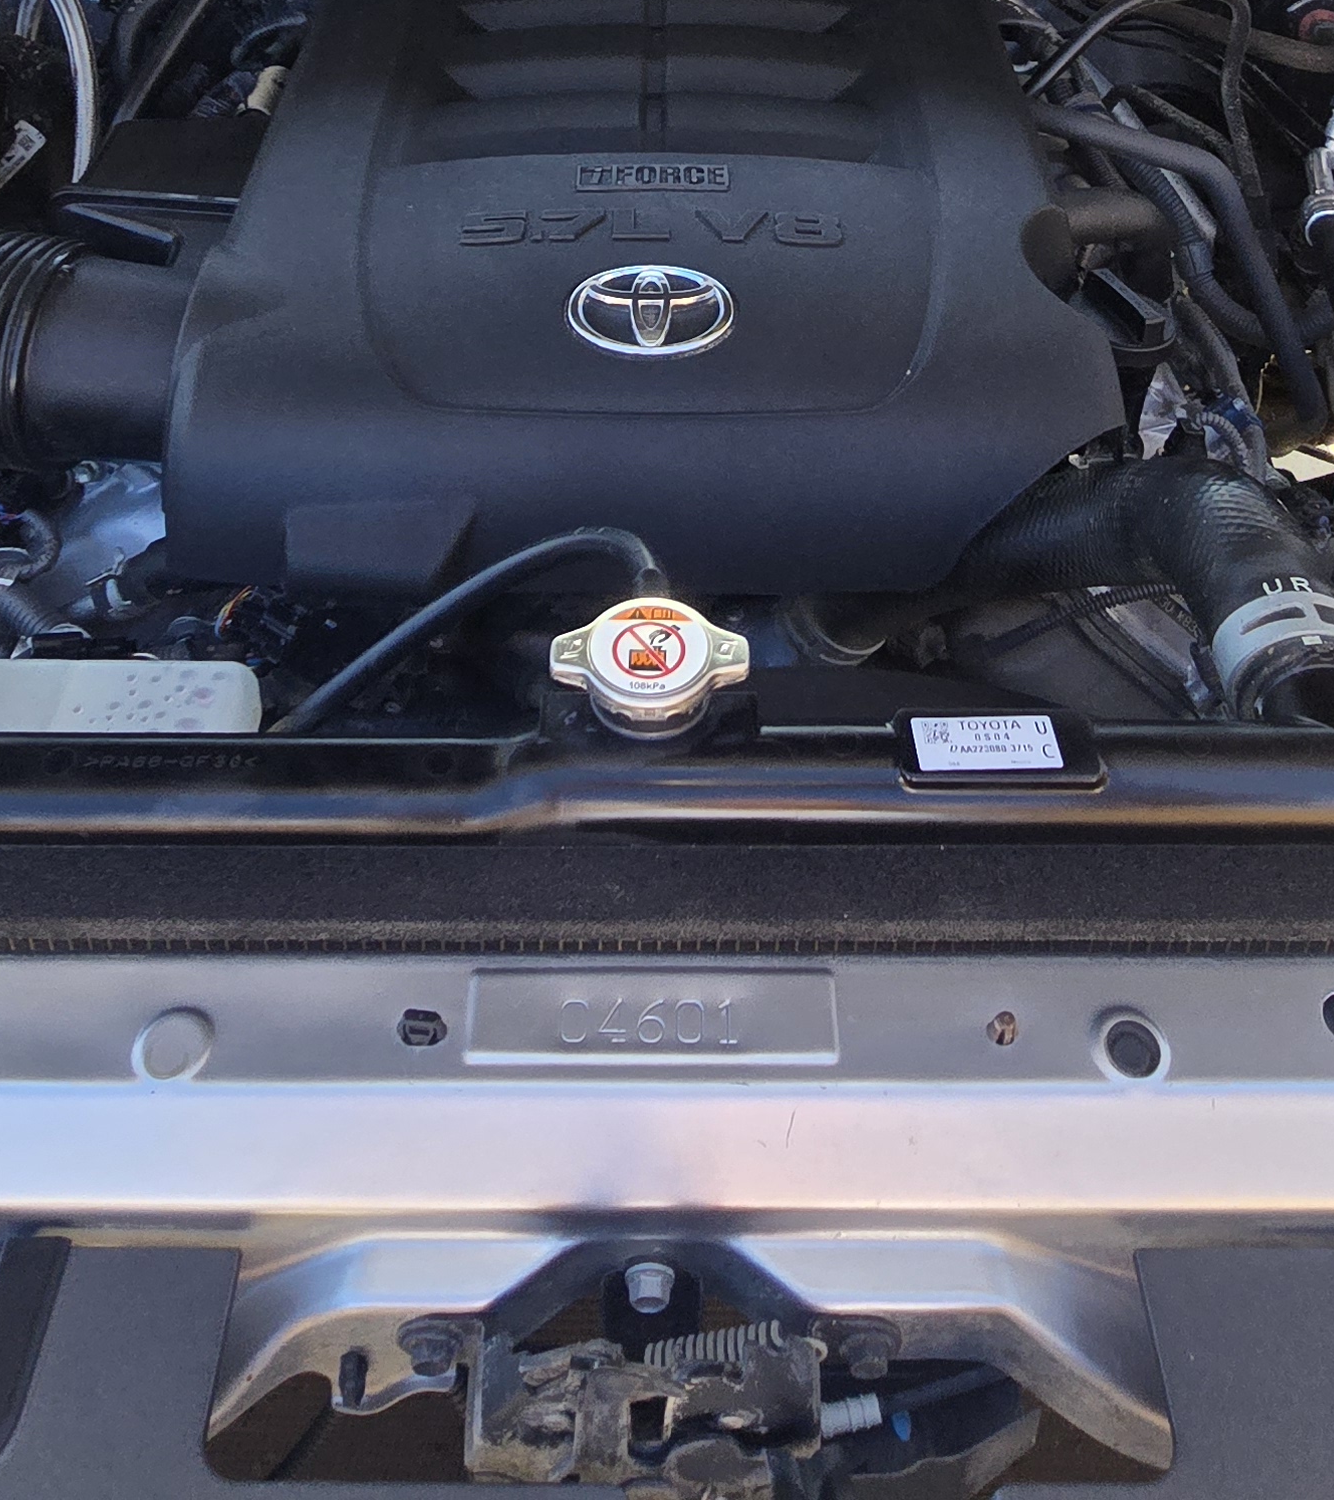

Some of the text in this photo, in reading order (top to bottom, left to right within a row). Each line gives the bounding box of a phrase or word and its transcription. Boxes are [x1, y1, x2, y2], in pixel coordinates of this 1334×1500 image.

[460, 208, 845, 247] 5.7L V8
[629, 680, 667, 691] 108kPa
[958, 719, 1048, 735] TOYOTA U
[1042, 743, 1055, 759] C
